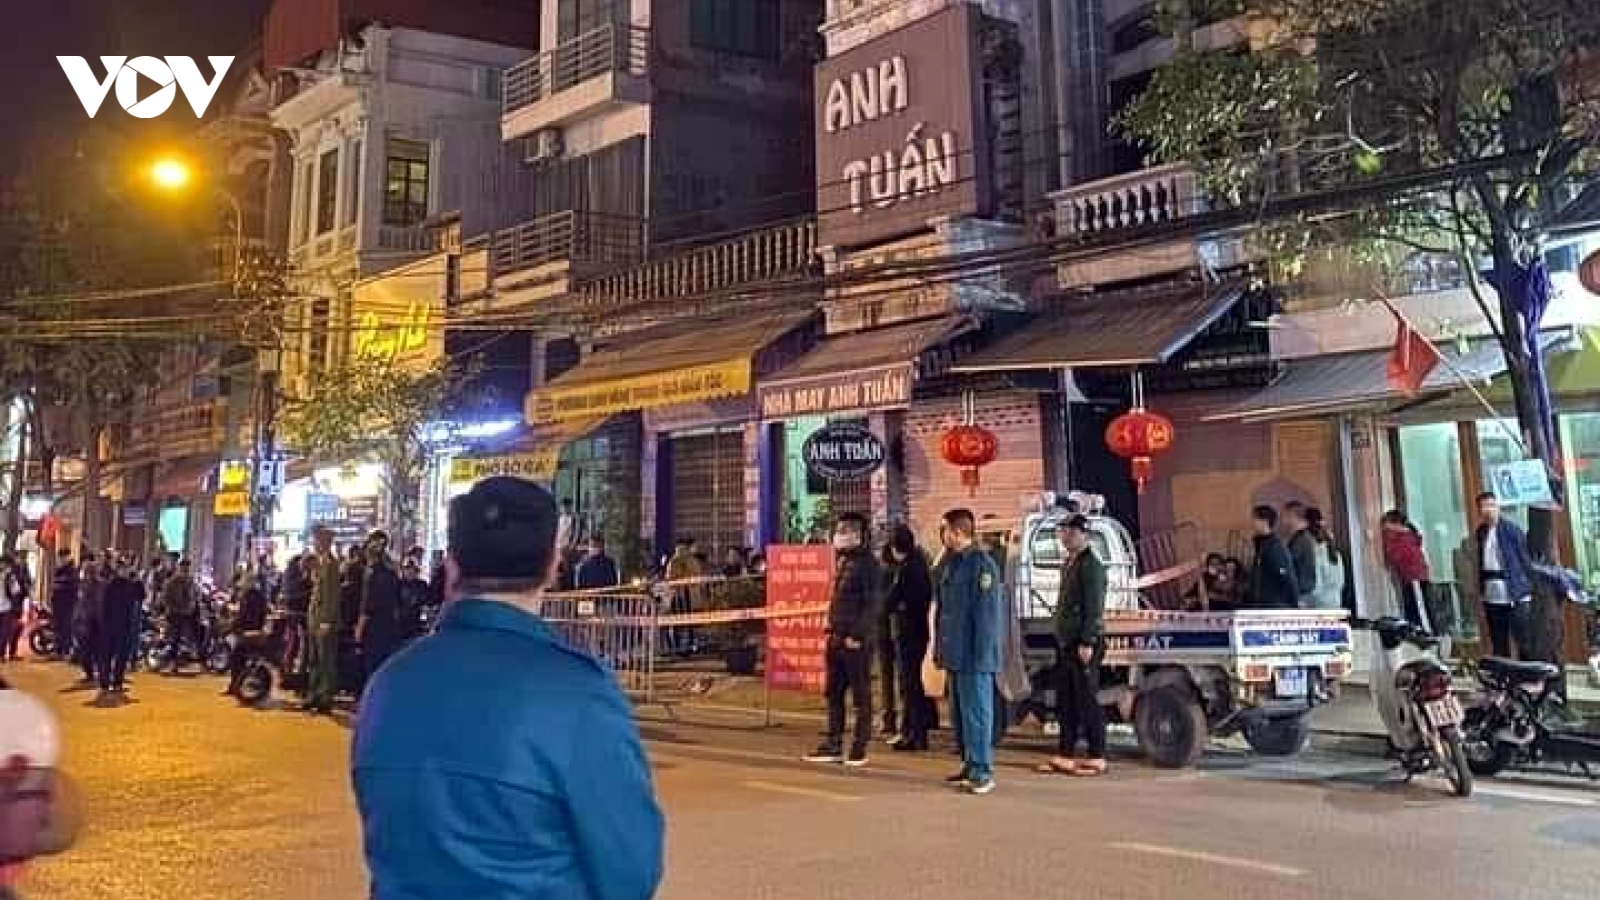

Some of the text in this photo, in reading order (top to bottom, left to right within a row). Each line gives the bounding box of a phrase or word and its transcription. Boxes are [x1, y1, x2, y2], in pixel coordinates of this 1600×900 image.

[826, 56, 908, 131] ANH
[843, 122, 958, 213] TUẤN
[828, 384, 859, 408] ANH
[861, 369, 905, 404] TUẤN
[810, 440, 841, 460] ANH
[1133, 630, 1174, 650] SÁT
